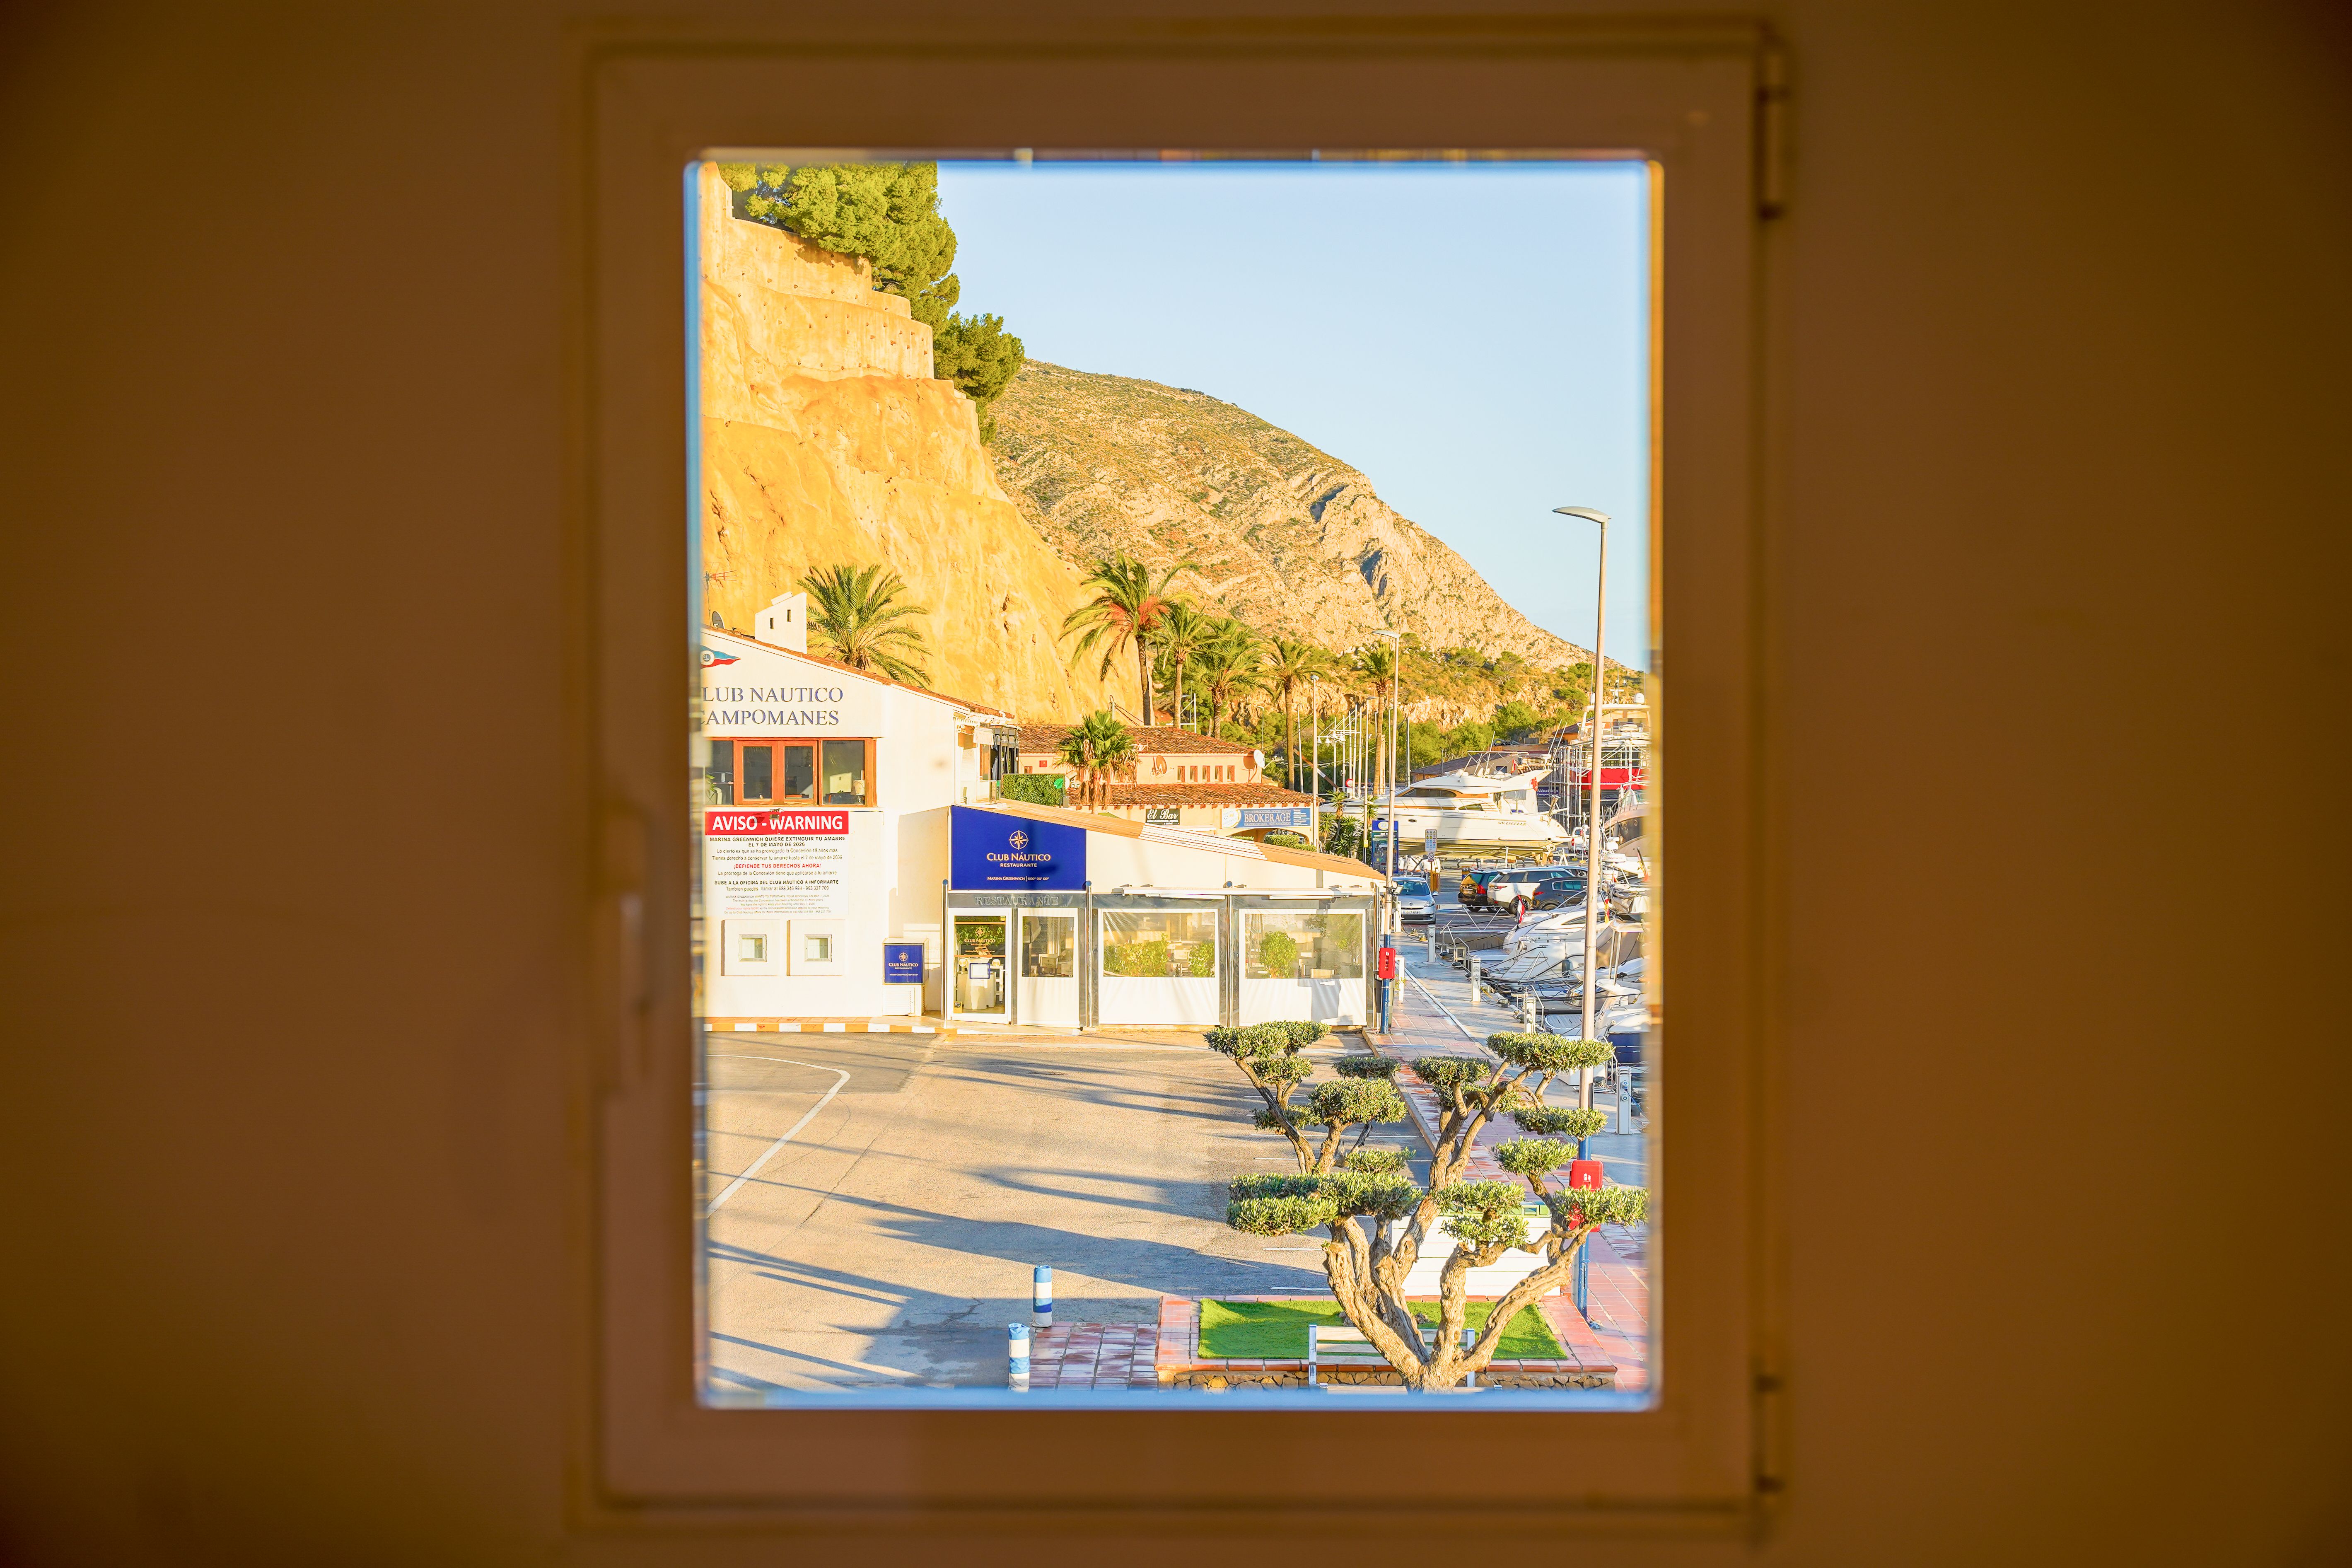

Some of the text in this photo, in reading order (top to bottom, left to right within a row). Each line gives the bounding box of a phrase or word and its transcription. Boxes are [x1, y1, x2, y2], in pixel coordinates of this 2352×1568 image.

[701, 687, 843, 702] LUB NAUTICO
[1147, 808, 1178, 820] El Bar
[1244, 813, 1291, 823] BROKERAGE
[712, 815, 758, 831] AVISO
[769, 815, 843, 831] WARNING
[987, 852, 1051, 861] CLUB NÁUTICO
[975, 896, 1059, 906] RESTAURANTE
